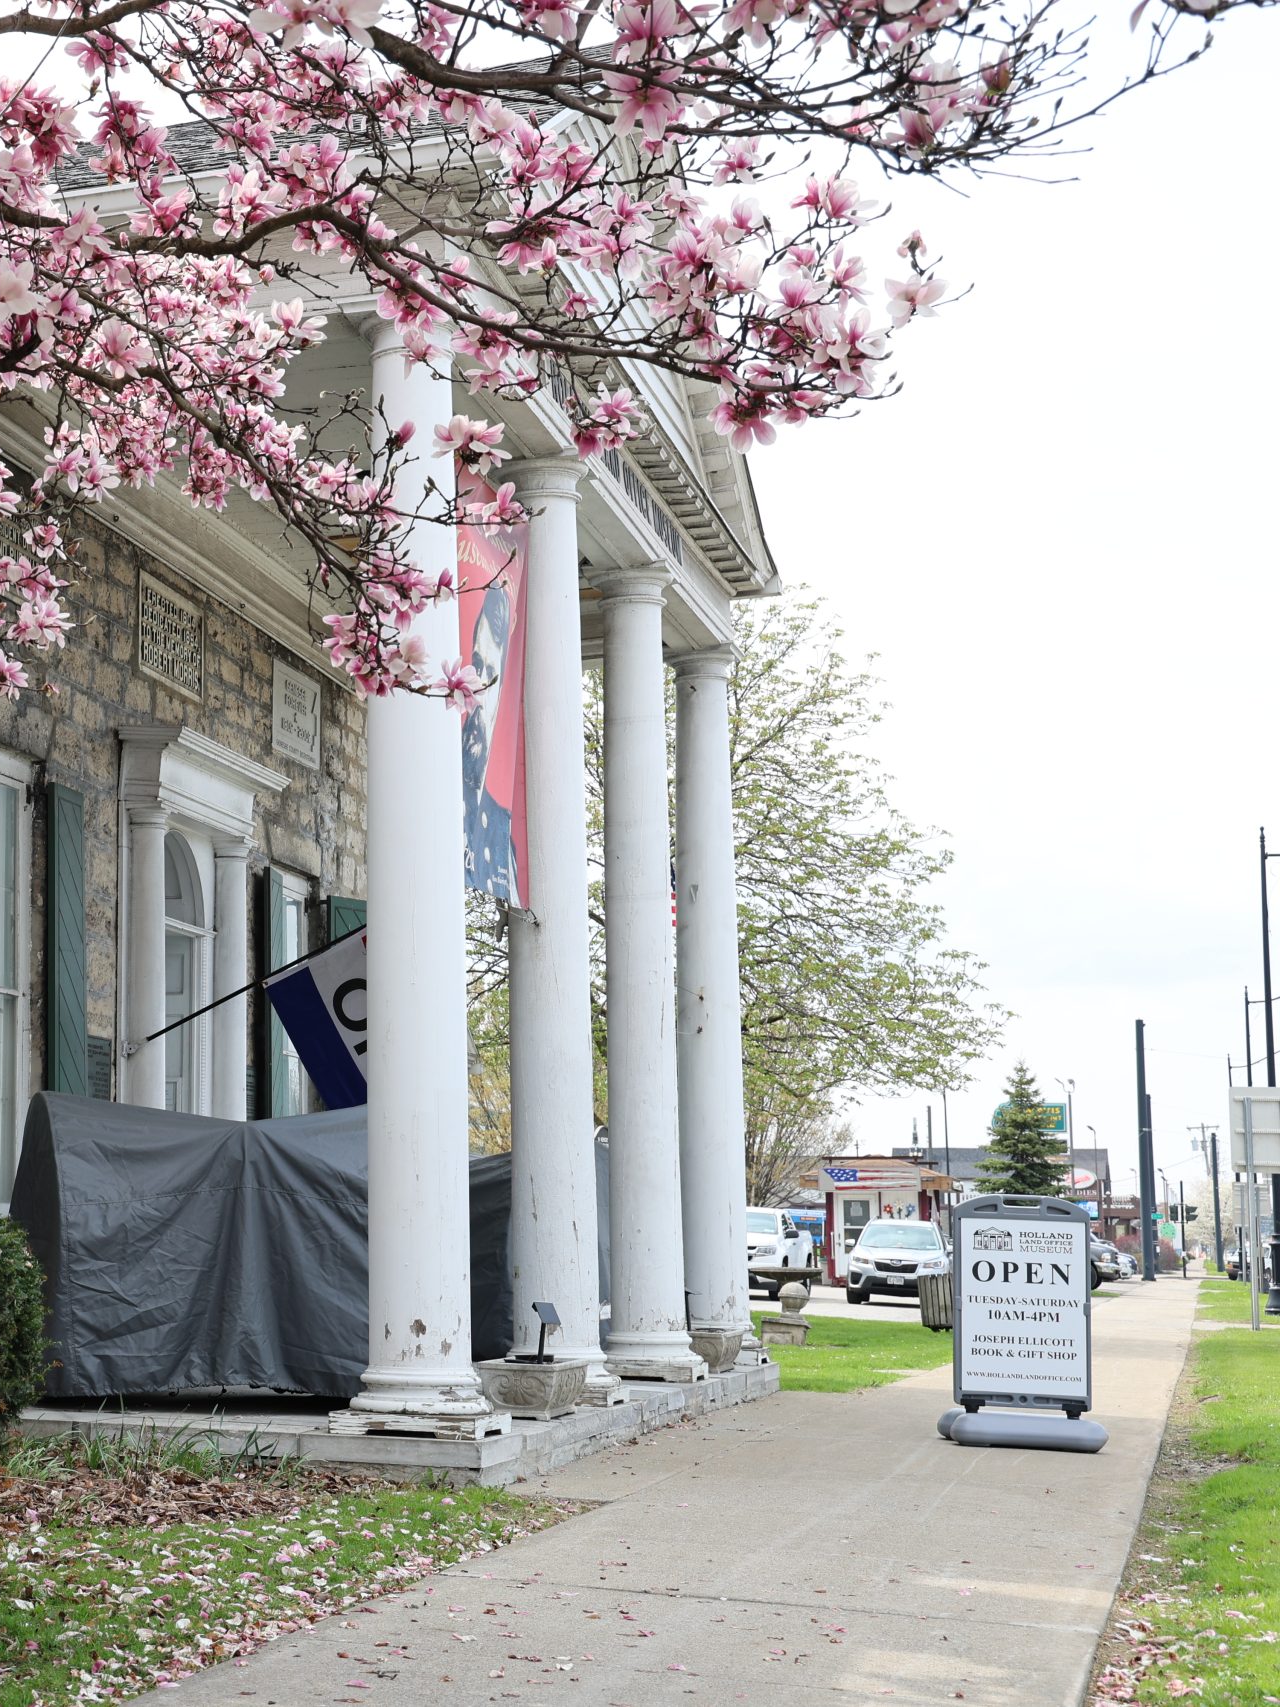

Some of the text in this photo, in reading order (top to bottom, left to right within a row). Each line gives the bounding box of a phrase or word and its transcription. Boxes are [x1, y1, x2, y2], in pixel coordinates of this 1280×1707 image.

[145, 586, 177, 618] ERECTED
[142, 603, 180, 637] DEDICATED
[141, 622, 201, 668] TO THE MEMORY OF
[141, 641, 172, 676] ROBERT
[1019, 1231, 1073, 1240] HOLLAND
[1019, 1245, 1073, 1254] MUSEUM
[972, 1260, 1071, 1285] OPEN
[967, 1295, 1080, 1308] TUESDAY-SATURDAY
[988, 1309, 1060, 1323] 10AM-4PM
[972, 1334, 1075, 1347] JOSEPH ELLICOTT
[971, 1347, 1077, 1361] BOOK & GIFT SHOP
[966, 1371, 1082, 1383] WWW.HOLLANDLANDOFFICE.COM
